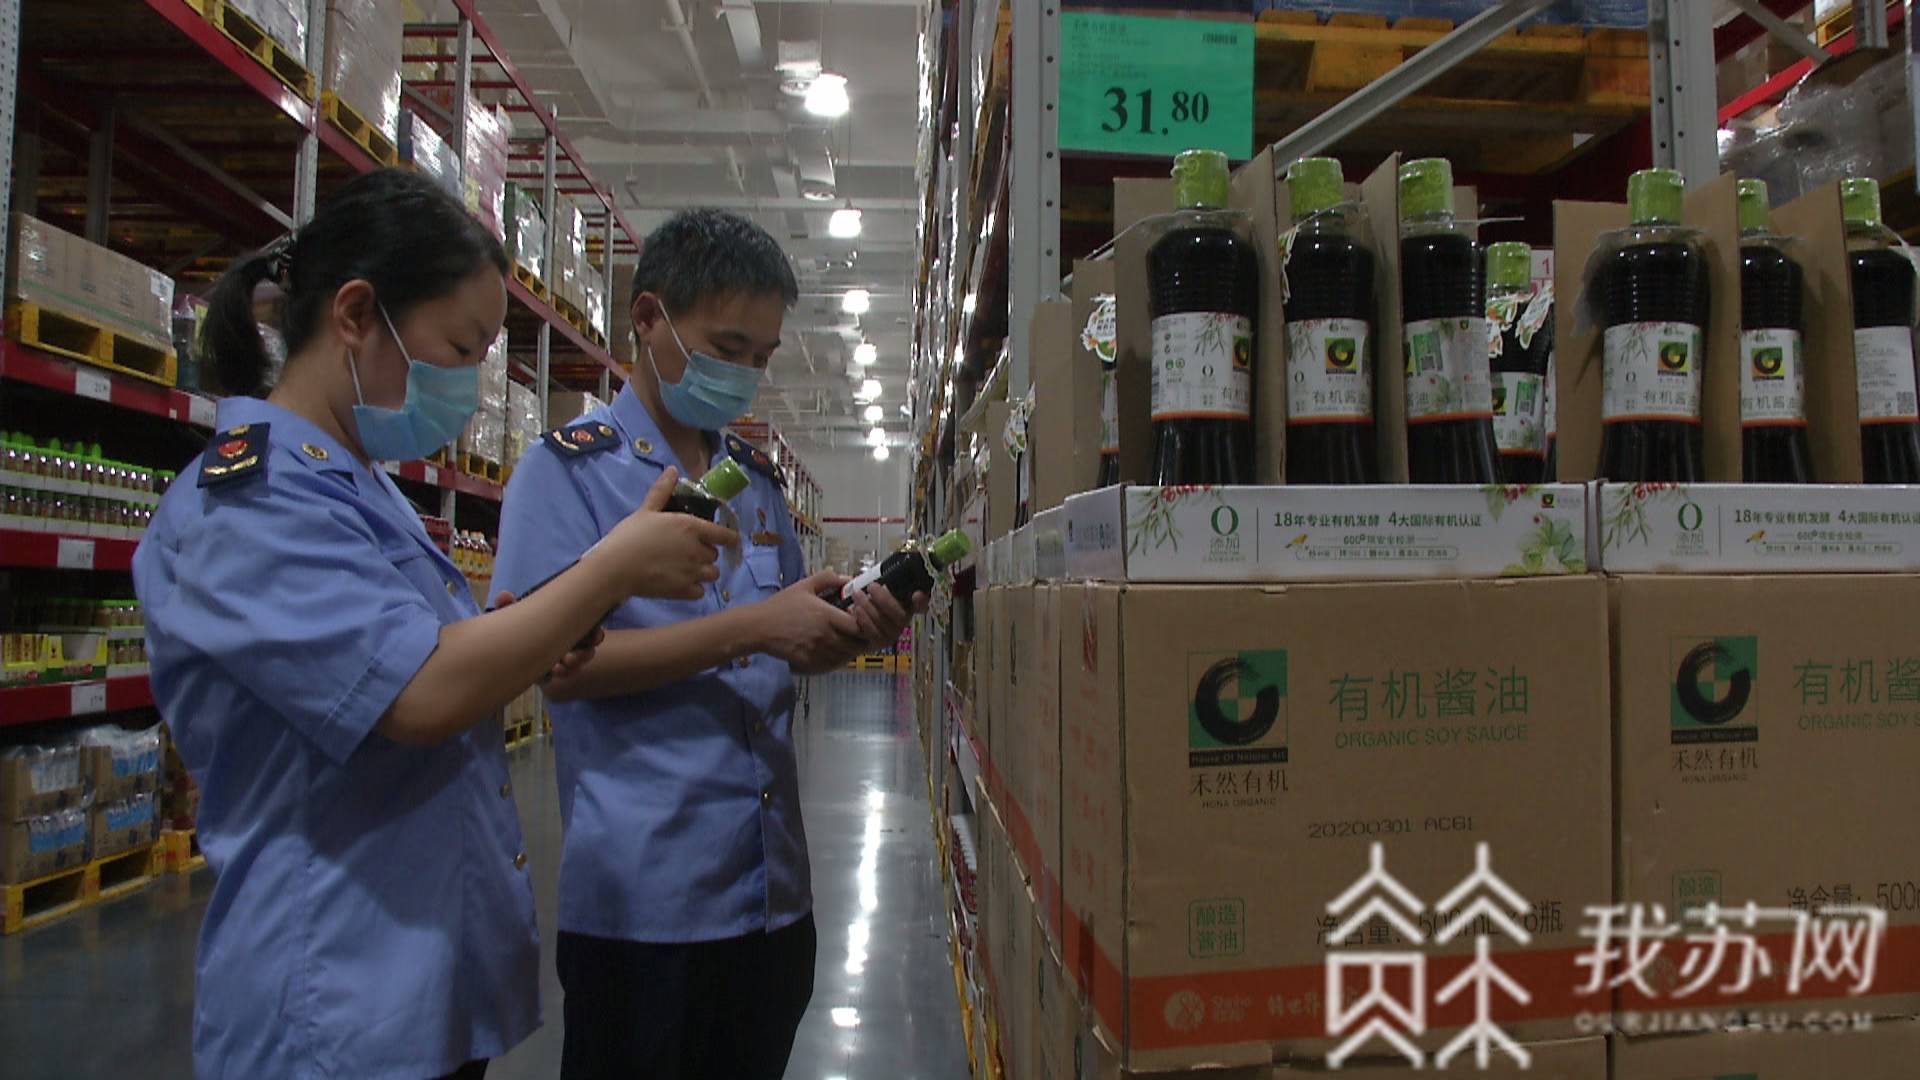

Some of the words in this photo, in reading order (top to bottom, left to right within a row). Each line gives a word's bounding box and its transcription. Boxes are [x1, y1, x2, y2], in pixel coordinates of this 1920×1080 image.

[1102, 87, 1209, 135] 31.80
[1273, 512, 1379, 527] 18年专业有机发酵
[1388, 511, 1482, 526] 4大国际有机认证
[1329, 665, 1528, 722] 有机酱油
[1335, 729, 1418, 748] ORGANIC
[1425, 727, 1461, 745] SOY
[1467, 724, 1528, 743] SAUCE
[1672, 747, 1758, 771] 禾然有机
[1190, 769, 1288, 796] 禾然有机
[1309, 818, 1411, 839] 20200301
